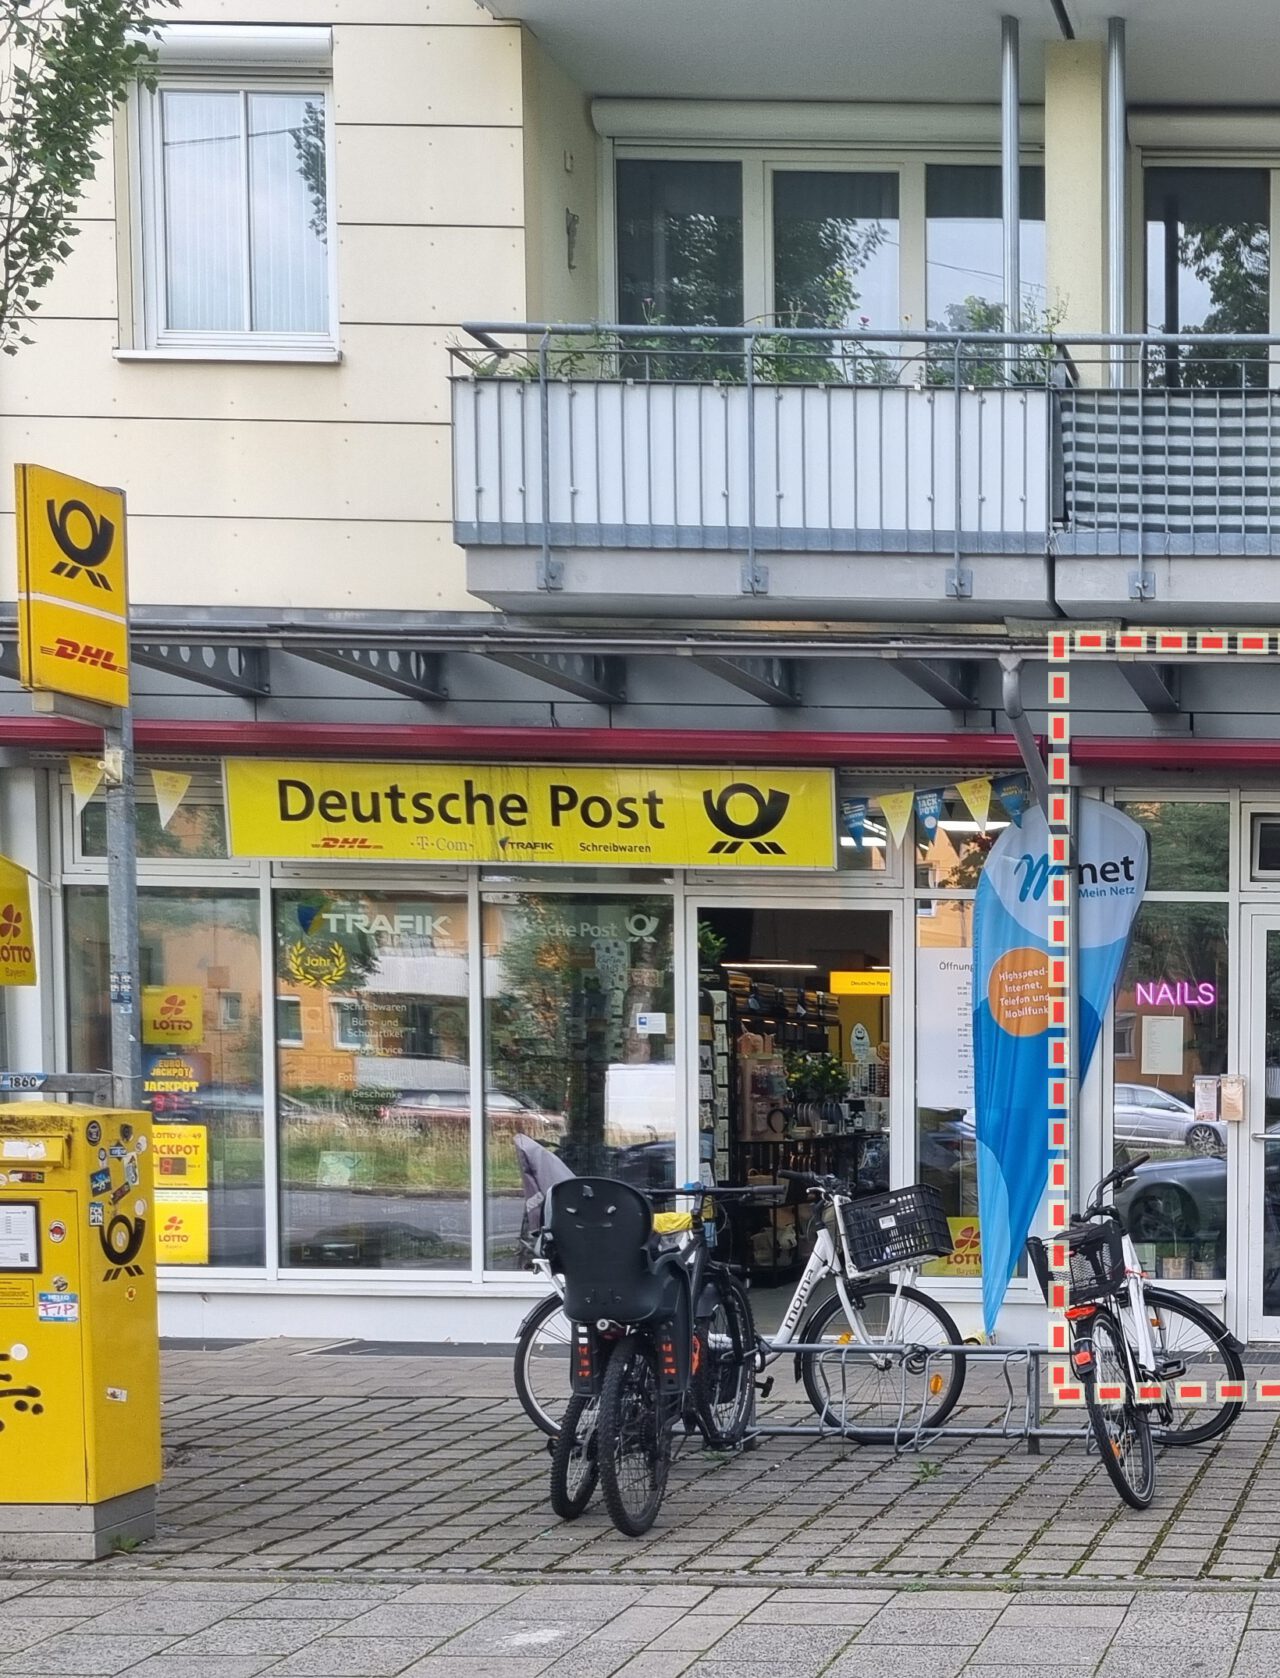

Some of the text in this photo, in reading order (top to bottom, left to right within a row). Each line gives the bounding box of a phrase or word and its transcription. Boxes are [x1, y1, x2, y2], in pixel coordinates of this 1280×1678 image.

[54, 637, 116, 673] DHL
[278, 779, 666, 830] Deutsche Post
[321, 837, 369, 849] DHL
[508, 841, 554, 850] TRAFIK
[579, 842, 652, 854] Schreibwaren
[1079, 886, 1135, 898] Mein Netz
[321, 913, 452, 936] TRAFIK
[580, 922, 619, 937] Post
[0, 945, 32, 963] OTTO
[999, 966, 1048, 981] Highspeed-
[1004, 981, 1043, 993] Internet,
[1136, 981, 1215, 1005] NAILS
[1000, 993, 1050, 1007] Telefon und
[343, 1002, 407, 1012] Schreibwaren
[1005, 1006, 1049, 1019] Mobilfunk
[153, 1020, 193, 1031] LOTTO
[351, 1017, 399, 1027] Büro- und
[347, 1028, 404, 1038] Schulartikel
[10, 1077, 37, 1088] 1860
[144, 1081, 200, 1093] JACKPOT
[351, 1089, 403, 1100] Geschenke
[153, 1144, 201, 1156] ACKPOT
[158, 1233, 190, 1243] LOTTO
